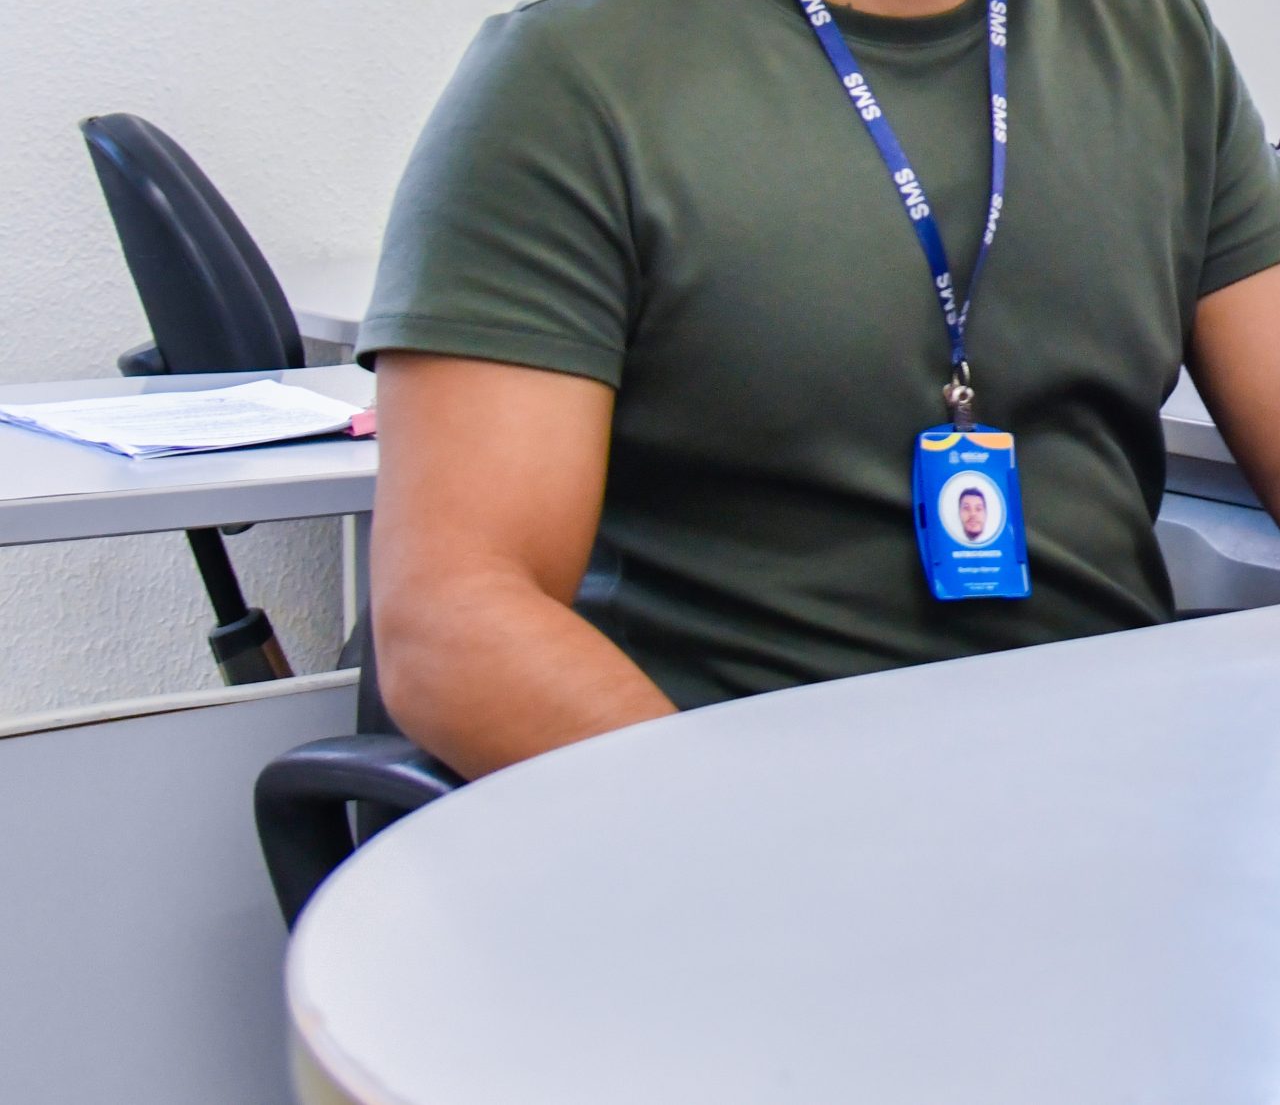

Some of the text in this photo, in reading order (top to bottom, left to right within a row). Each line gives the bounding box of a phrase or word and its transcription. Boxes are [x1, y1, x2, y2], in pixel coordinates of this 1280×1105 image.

[989, 0, 1007, 48] SMS
[991, 93, 1008, 144] SMS
[843, 72, 882, 121] SMS
[894, 167, 931, 221] SMS
